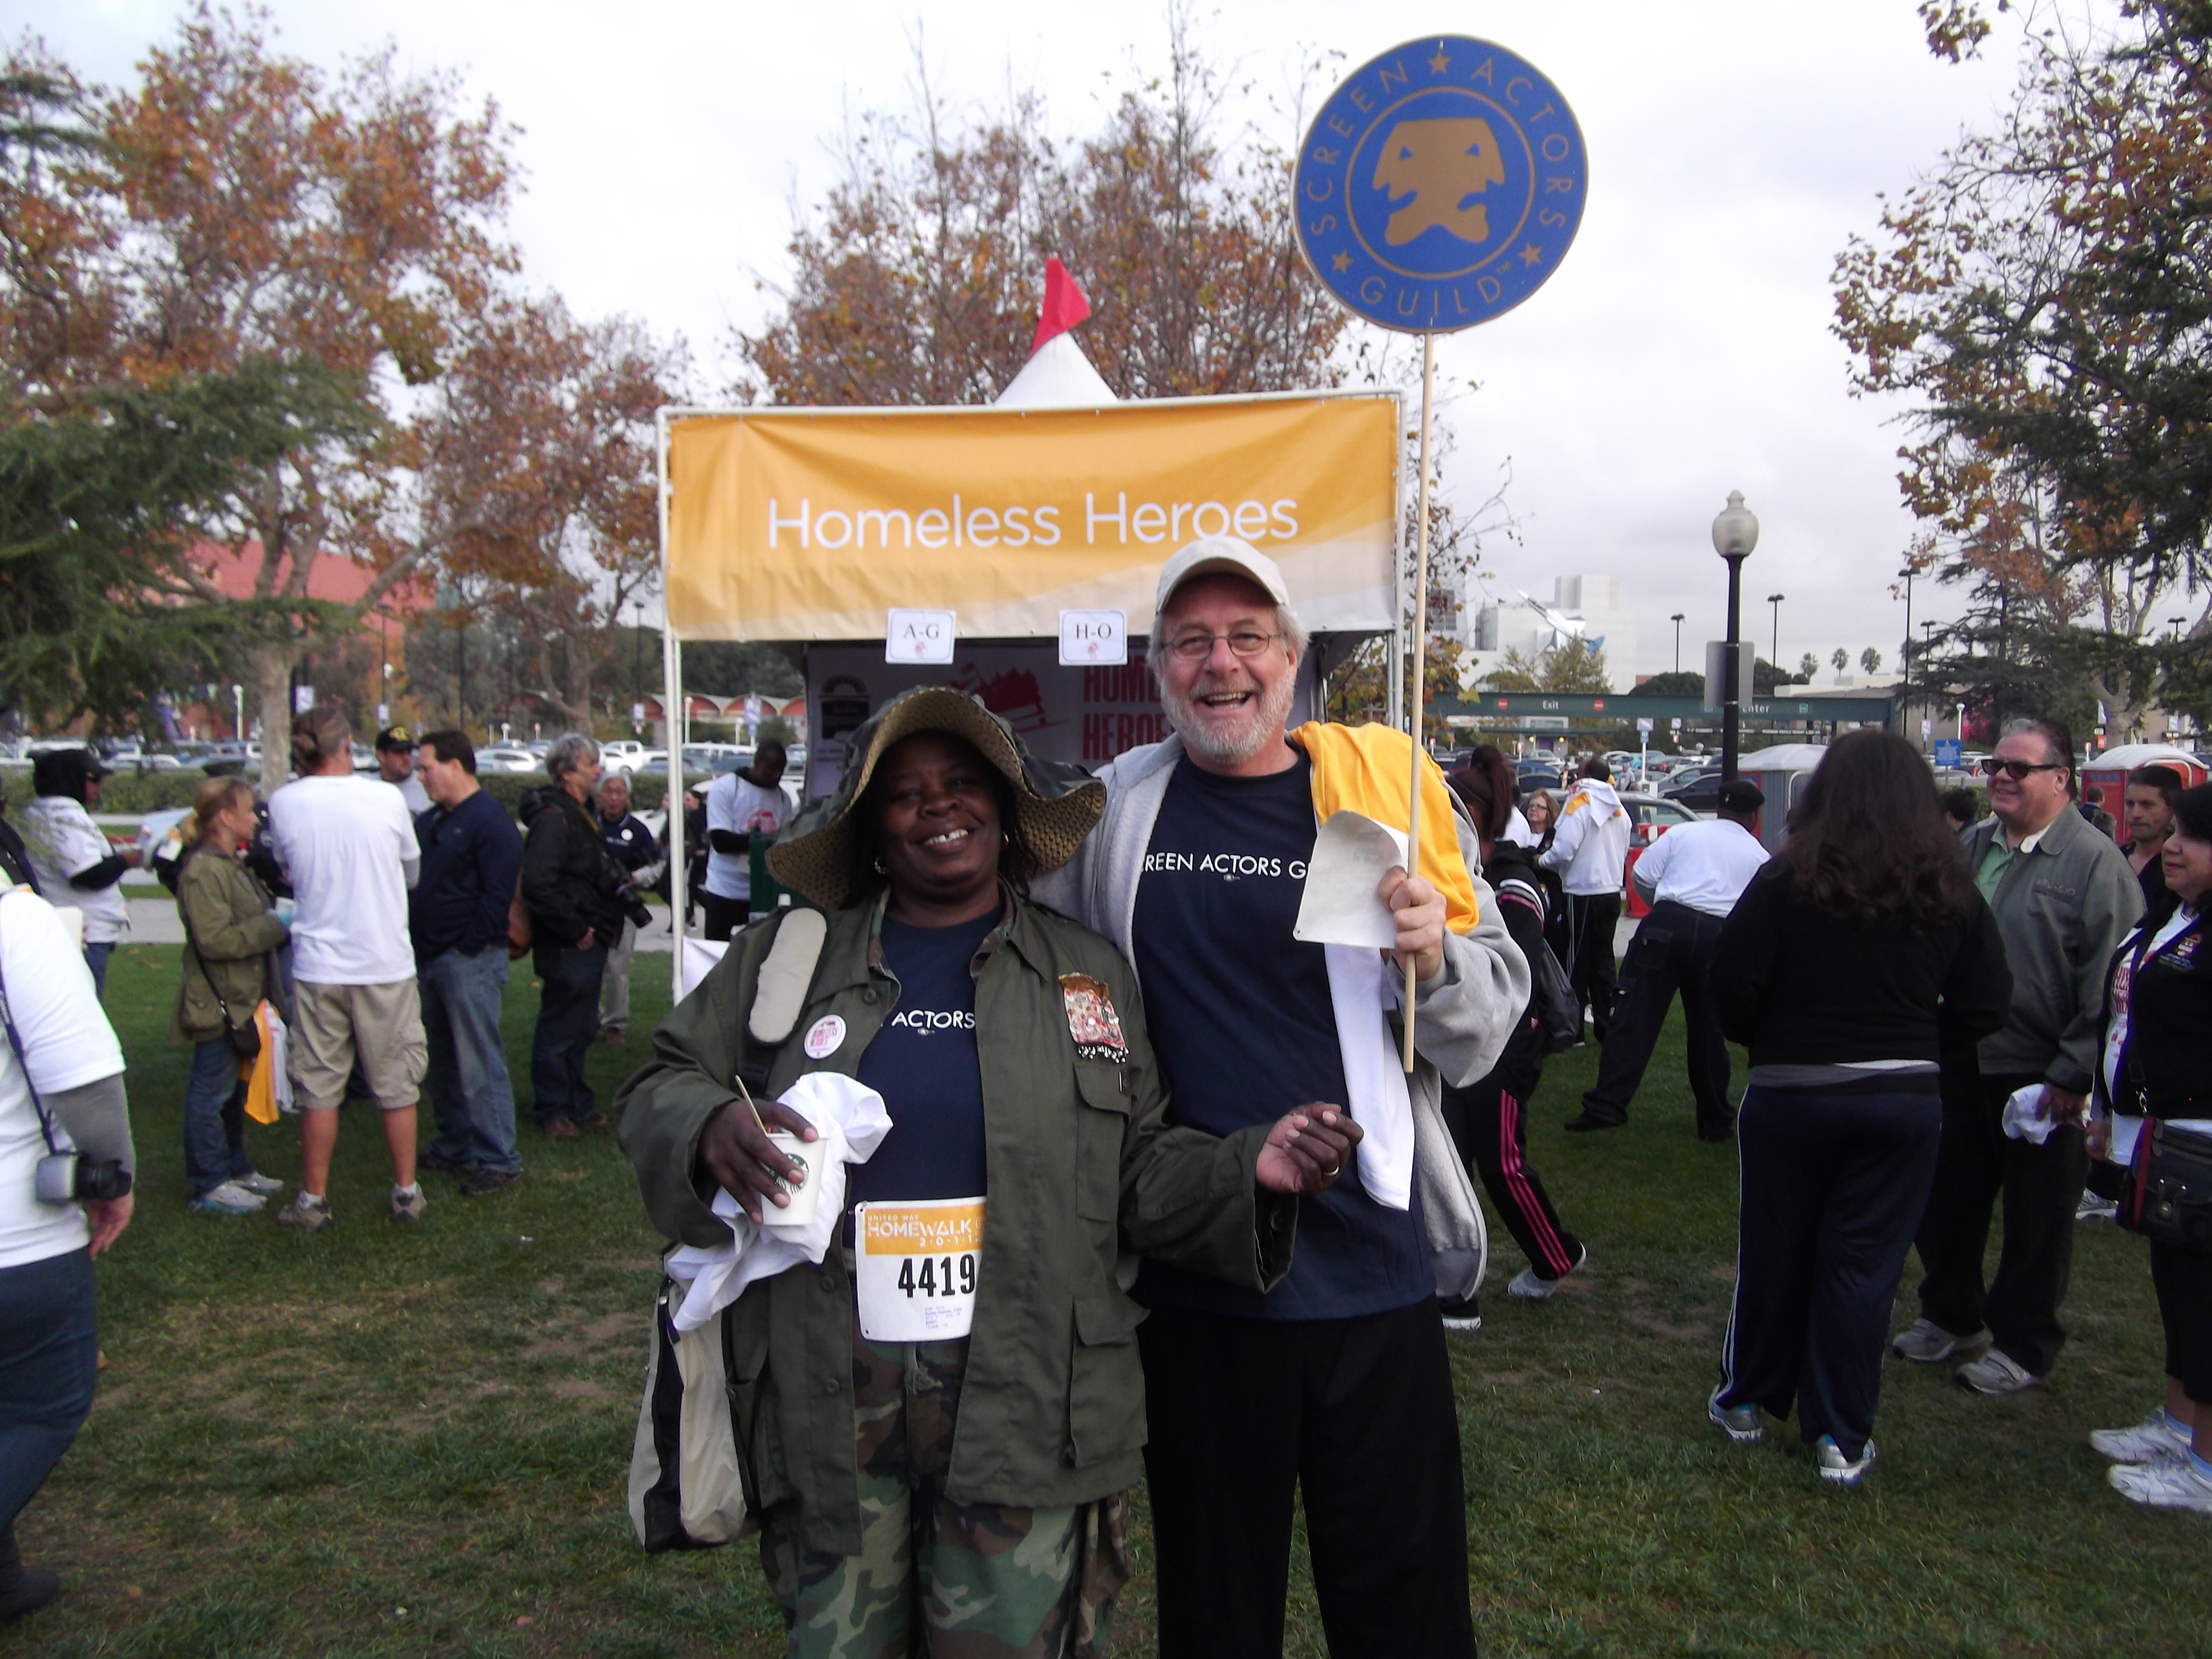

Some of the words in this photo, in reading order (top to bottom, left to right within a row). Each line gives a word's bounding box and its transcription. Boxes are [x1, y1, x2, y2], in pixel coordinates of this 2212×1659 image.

[1307, 58, 1408, 235] SCREEN
[1471, 58, 1573, 228] ACTORS
[1360, 275, 1502, 316] GUILD
[769, 493, 1060, 549] Homeless
[1085, 491, 1298, 544] Heroes
[903, 623, 940, 639] A-G
[1075, 623, 1112, 639] H-O
[1542, 700, 1559, 710] Exit
[1083, 713, 1177, 760] HEROE
[1145, 852, 1193, 872] REEN
[1199, 853, 1281, 877] ACTORS
[891, 1010, 975, 1029] ACTORS
[867, 1218, 972, 1238] HOMEWALK
[898, 1254, 975, 1298] 4419
